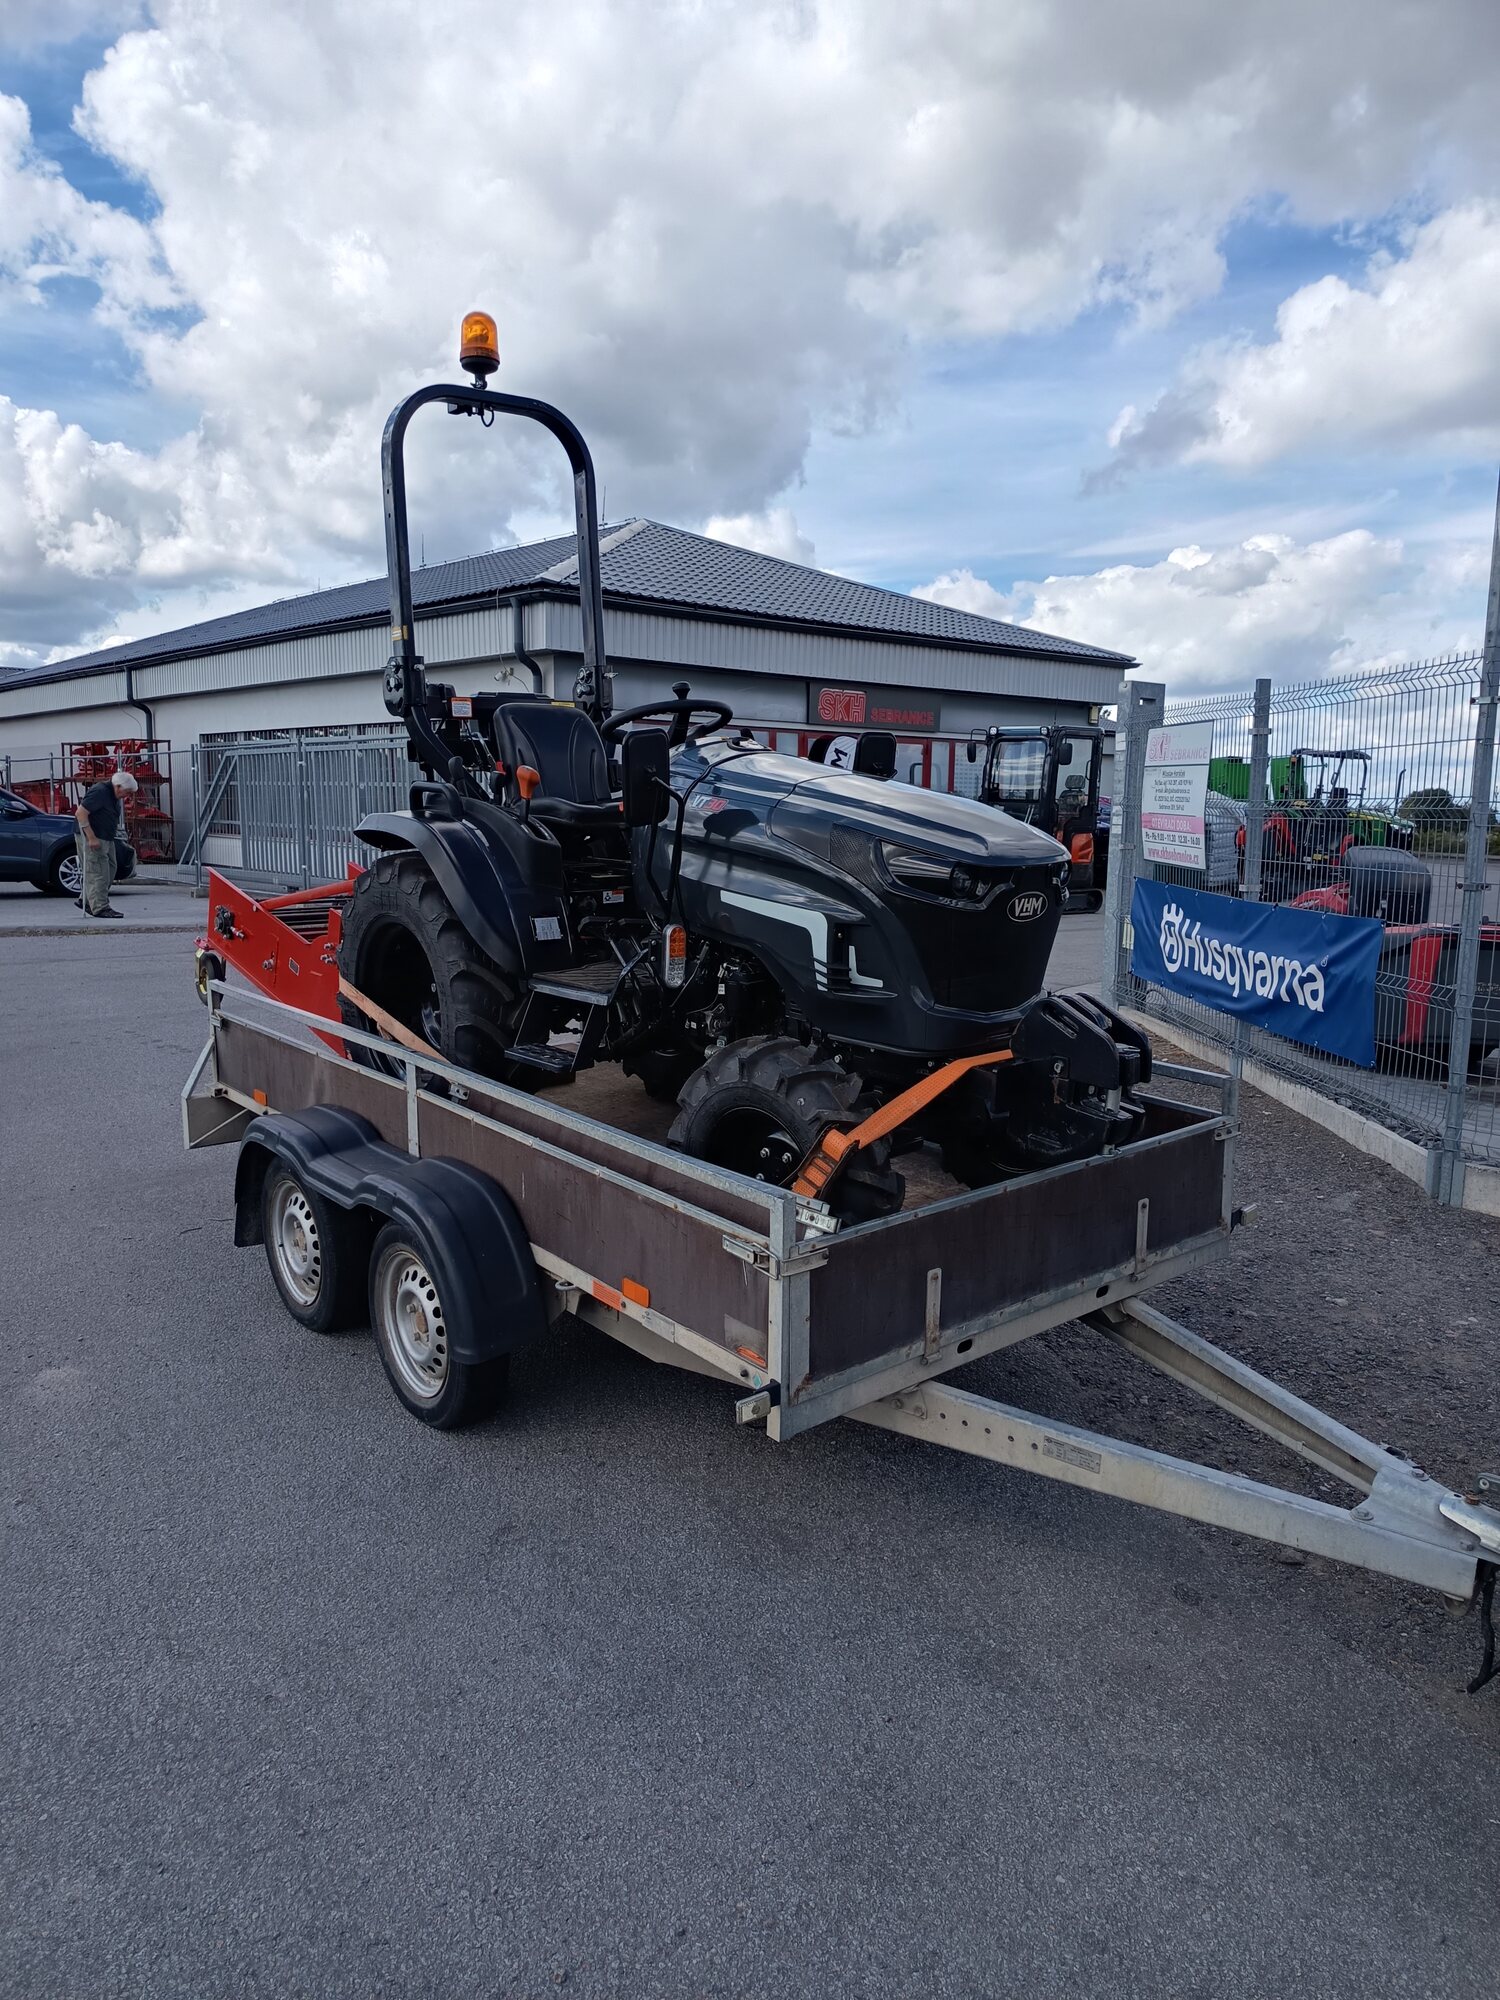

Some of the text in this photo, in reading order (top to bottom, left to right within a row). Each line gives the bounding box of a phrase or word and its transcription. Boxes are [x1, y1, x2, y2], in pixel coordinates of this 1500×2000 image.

[819, 688, 935, 726] SKH SEBRANICE
[1015, 897, 1043, 916] VHM
[1181, 918, 1325, 1013] Husqvarna
